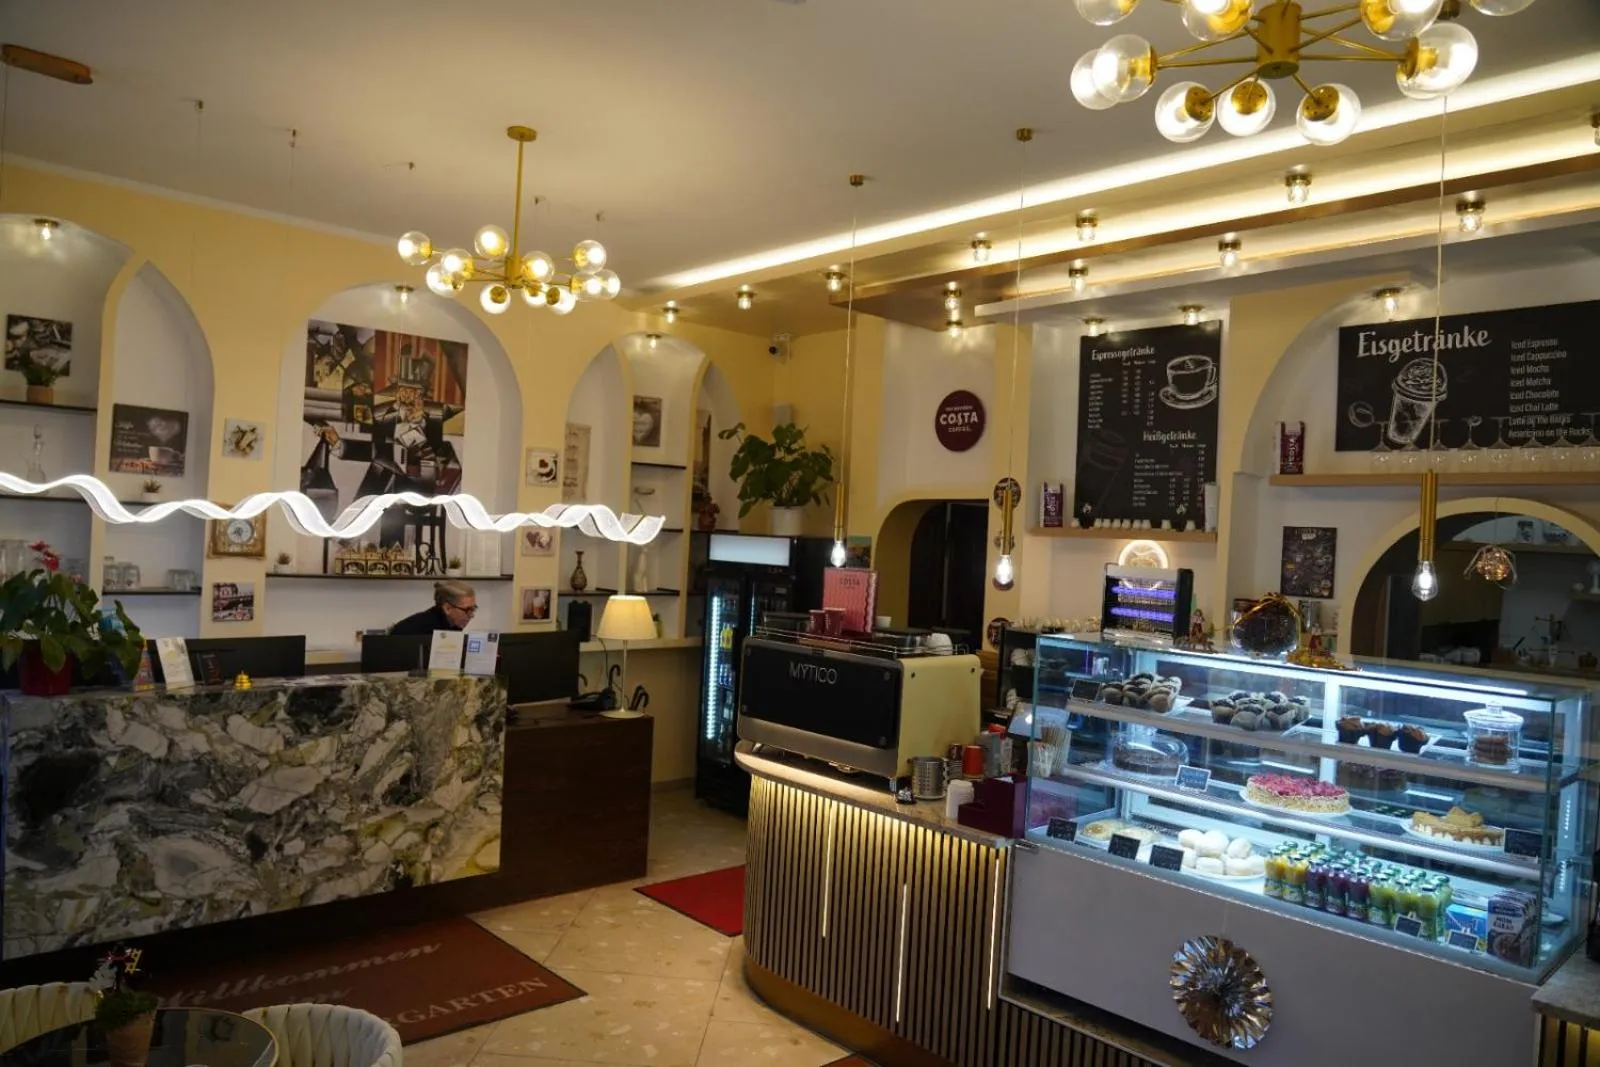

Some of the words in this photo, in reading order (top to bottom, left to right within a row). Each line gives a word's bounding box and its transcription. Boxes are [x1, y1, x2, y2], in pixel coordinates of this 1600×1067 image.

[1357, 325, 1493, 363] Eisgetränke
[939, 411, 979, 426] COSTA
[788, 661, 838, 685] MYTICO
